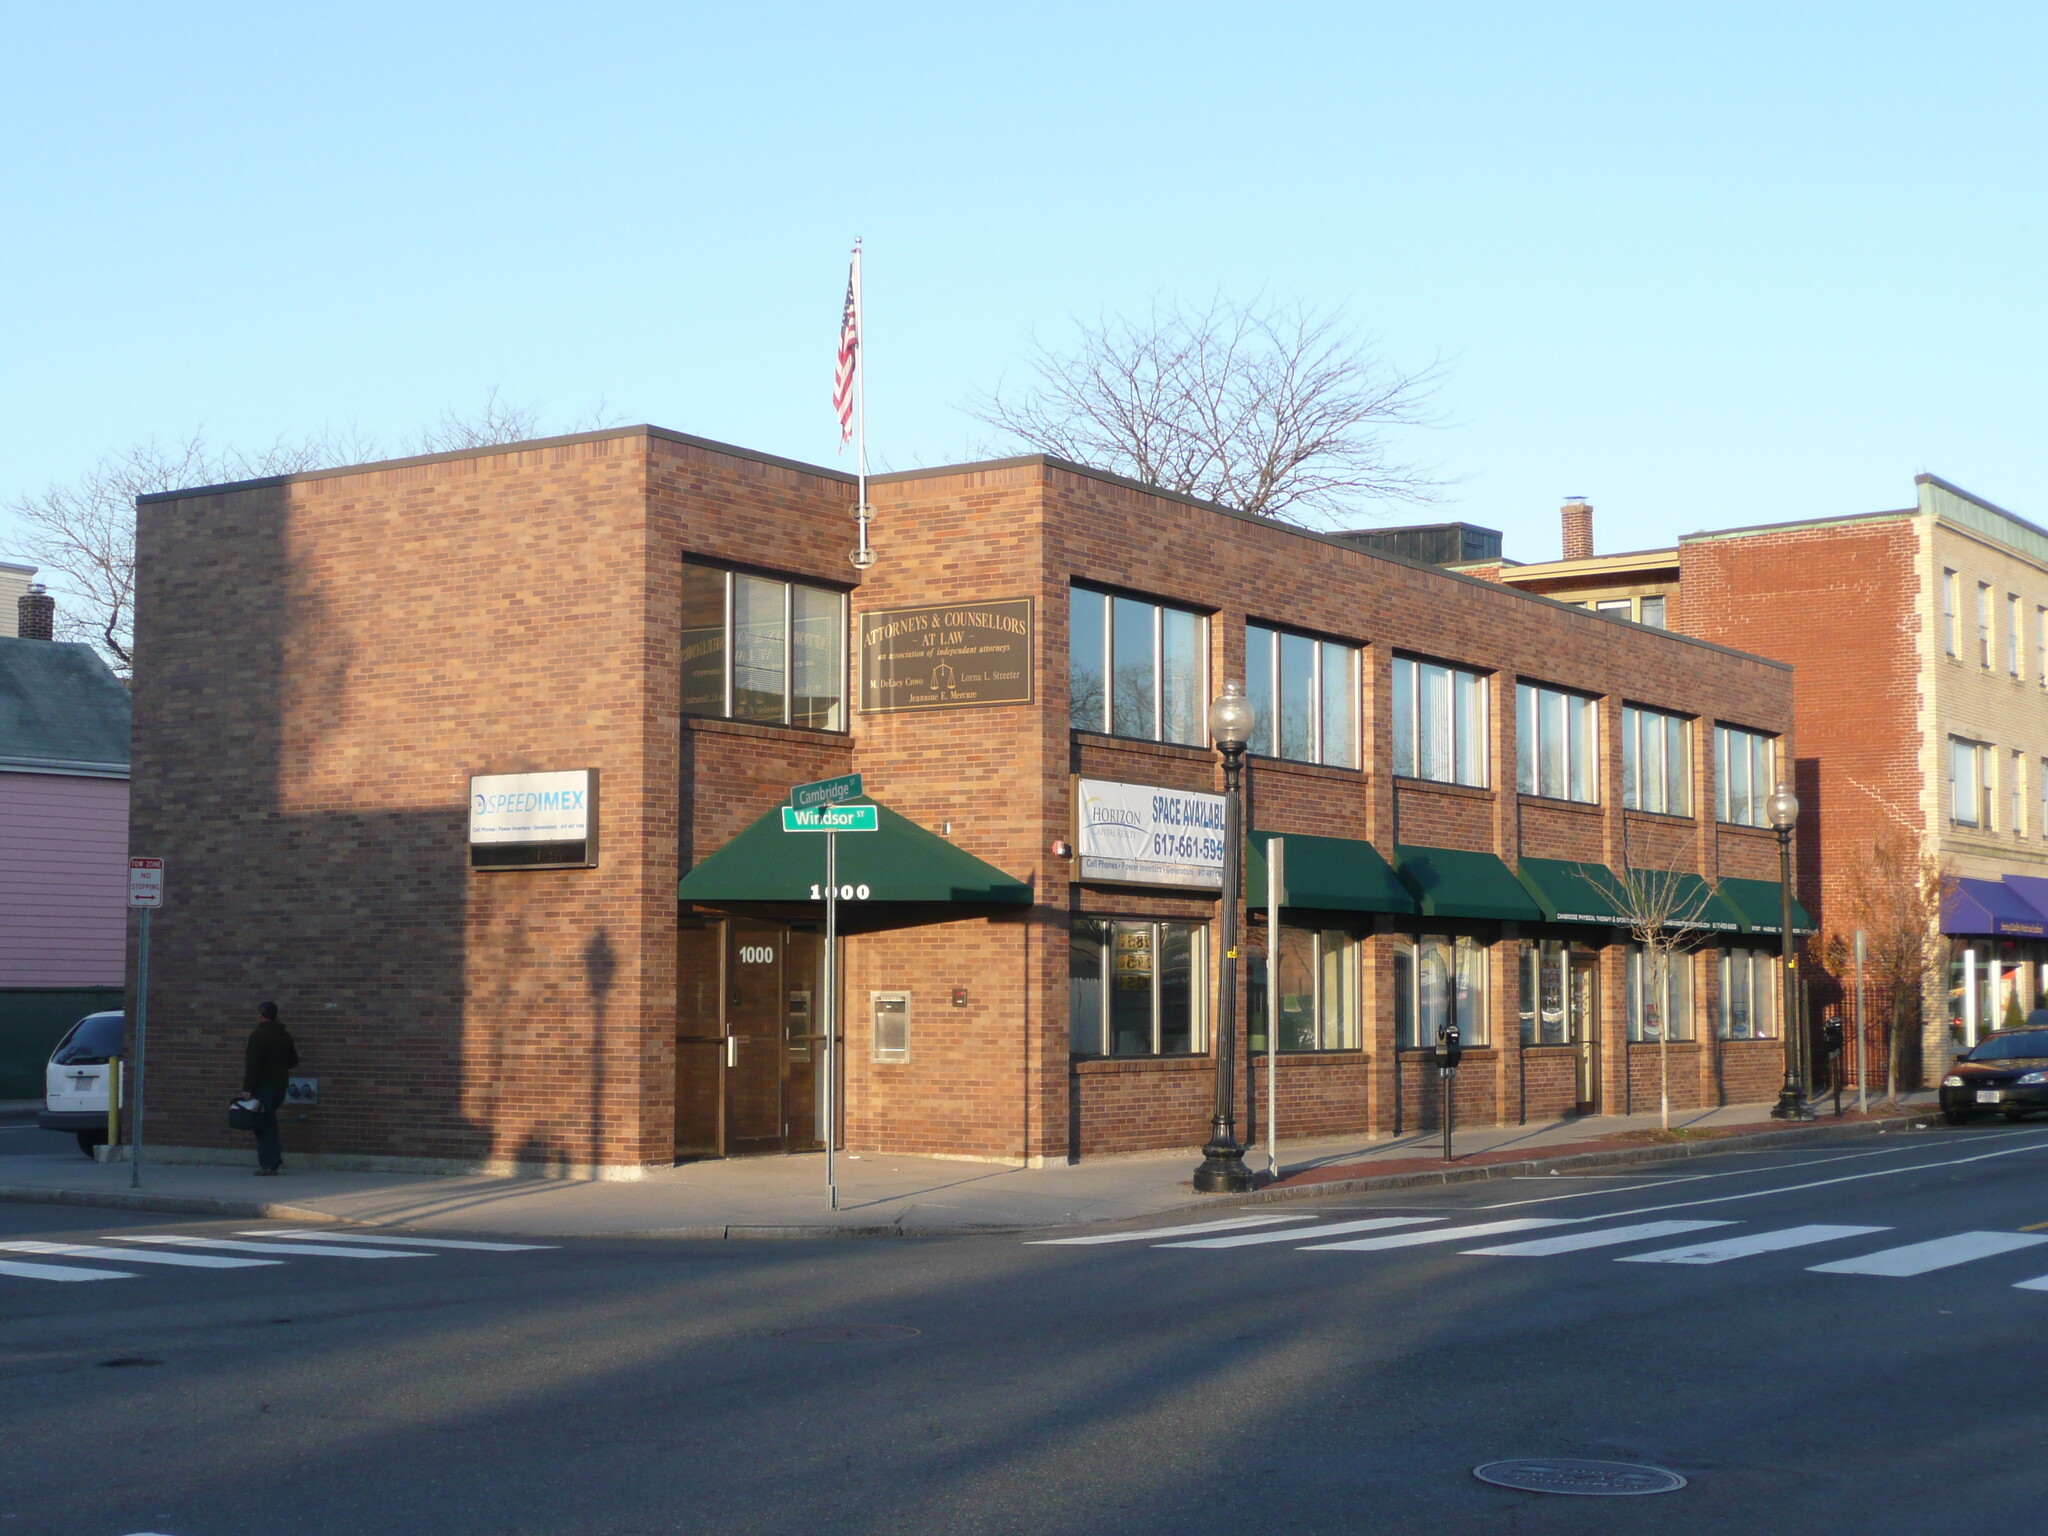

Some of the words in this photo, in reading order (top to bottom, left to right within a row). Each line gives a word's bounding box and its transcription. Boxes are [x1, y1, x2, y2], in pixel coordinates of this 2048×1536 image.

[863, 614, 928, 648] ATTORNEYS
[931, 613, 940, 628] &
[944, 611, 1026, 636] COUNSELLORS
[922, 633, 935, 647] AT
[940, 631, 964, 645] LAW
[877, 653, 887, 661] an
[888, 650, 924, 660] association
[926, 647, 935, 659] of
[936, 645, 977, 658] independant
[979, 644, 1011, 655] attorneys
[870, 679, 878, 689] M.
[880, 678, 903, 689] DeLacy
[961, 672, 982, 682] Lorna
[983, 671, 991, 680] L.
[992, 670, 1020, 680] Streeter
[909, 692, 938, 703] Jeannine
[940, 691, 948, 701] E.
[950, 690, 978, 700] Mercure
[799, 783, 849, 805] Cambridge
[849, 778, 856, 786] ST
[487, 790, 585, 815] SPEEDIMEX
[794, 810, 854, 825] Windsor
[856, 810, 865, 818] ST
[1092, 807, 1142, 826] HORIZON
[1152, 795, 1181, 826] SPACE
[1183, 799, 1225, 830] AVAILABL
[1093, 827, 1116, 838] CAPITAL
[1117, 827, 1136, 839] REALTY
[1154, 833, 1225, 861] 617-661-595
[1086, 858, 1098, 868] Cell
[1098, 859, 1118, 870] Phones
[1121, 861, 1138, 872] Power
[1139, 863, 1162, 874] Inverters
[1166, 865, 1194, 876] Generators
[131, 883, 160, 891] STOPPING
[739, 946, 773, 964] 1000
